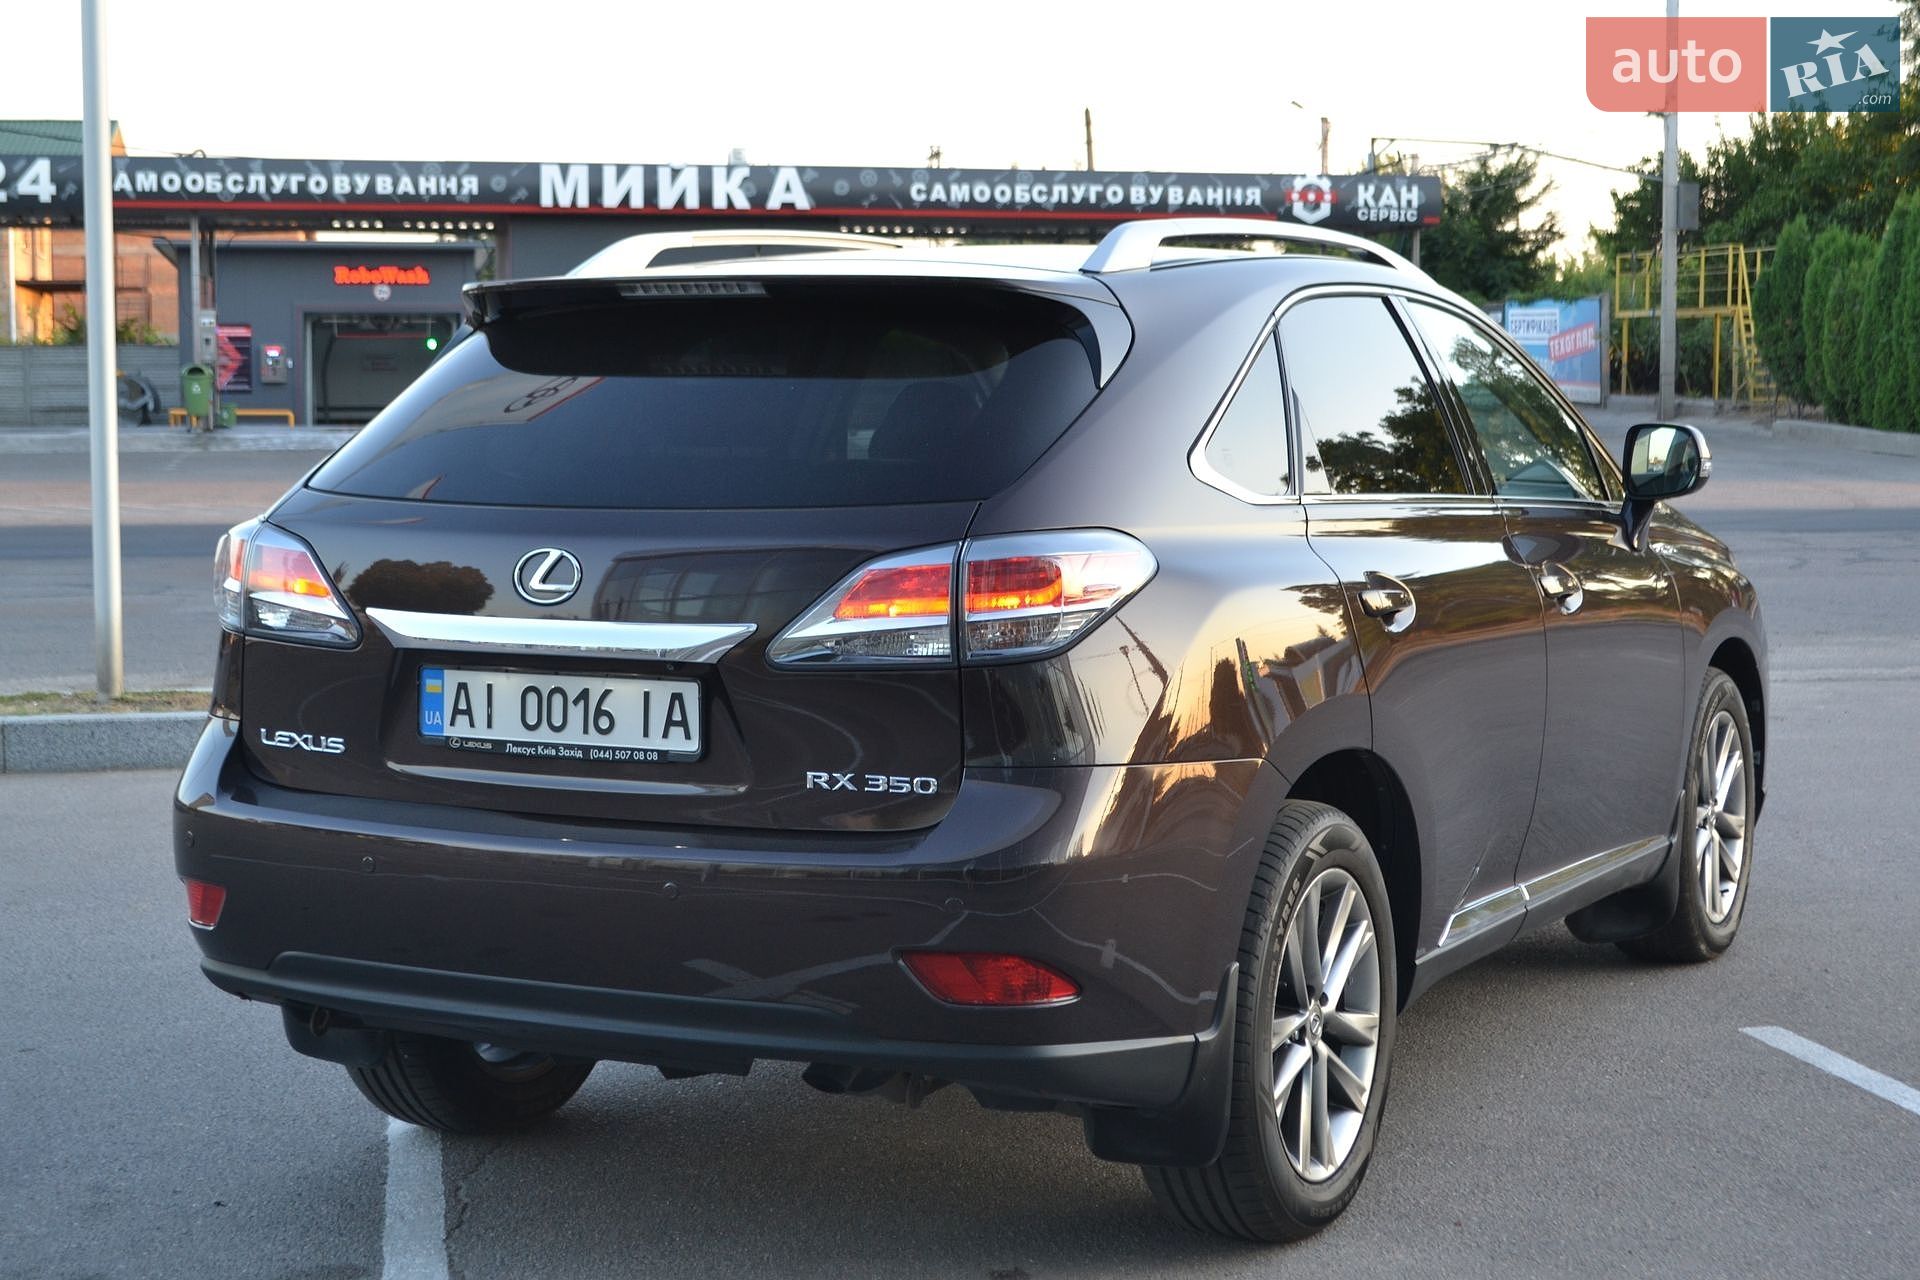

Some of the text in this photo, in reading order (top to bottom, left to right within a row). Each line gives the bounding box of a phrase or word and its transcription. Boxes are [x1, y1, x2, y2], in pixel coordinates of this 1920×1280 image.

[0, 156, 57, 203] 4
[113, 171, 480, 196] АМООБСЛУГОВУВАННЯ
[539, 162, 812, 211] МИЙКА
[910, 183, 1263, 207] САМООБСЛУГОВУВАННЯ
[1357, 183, 1419, 209] КАН
[1357, 208, 1418, 222] СЕРВІС
[425, 710, 442, 726] UA
[450, 681, 692, 741] AI 0016 IA
[260, 727, 346, 754] LEXUS
[505, 743, 658, 760] Лексус Київ Захід (044) 507 08 08
[806, 771, 938, 795] RX 350
